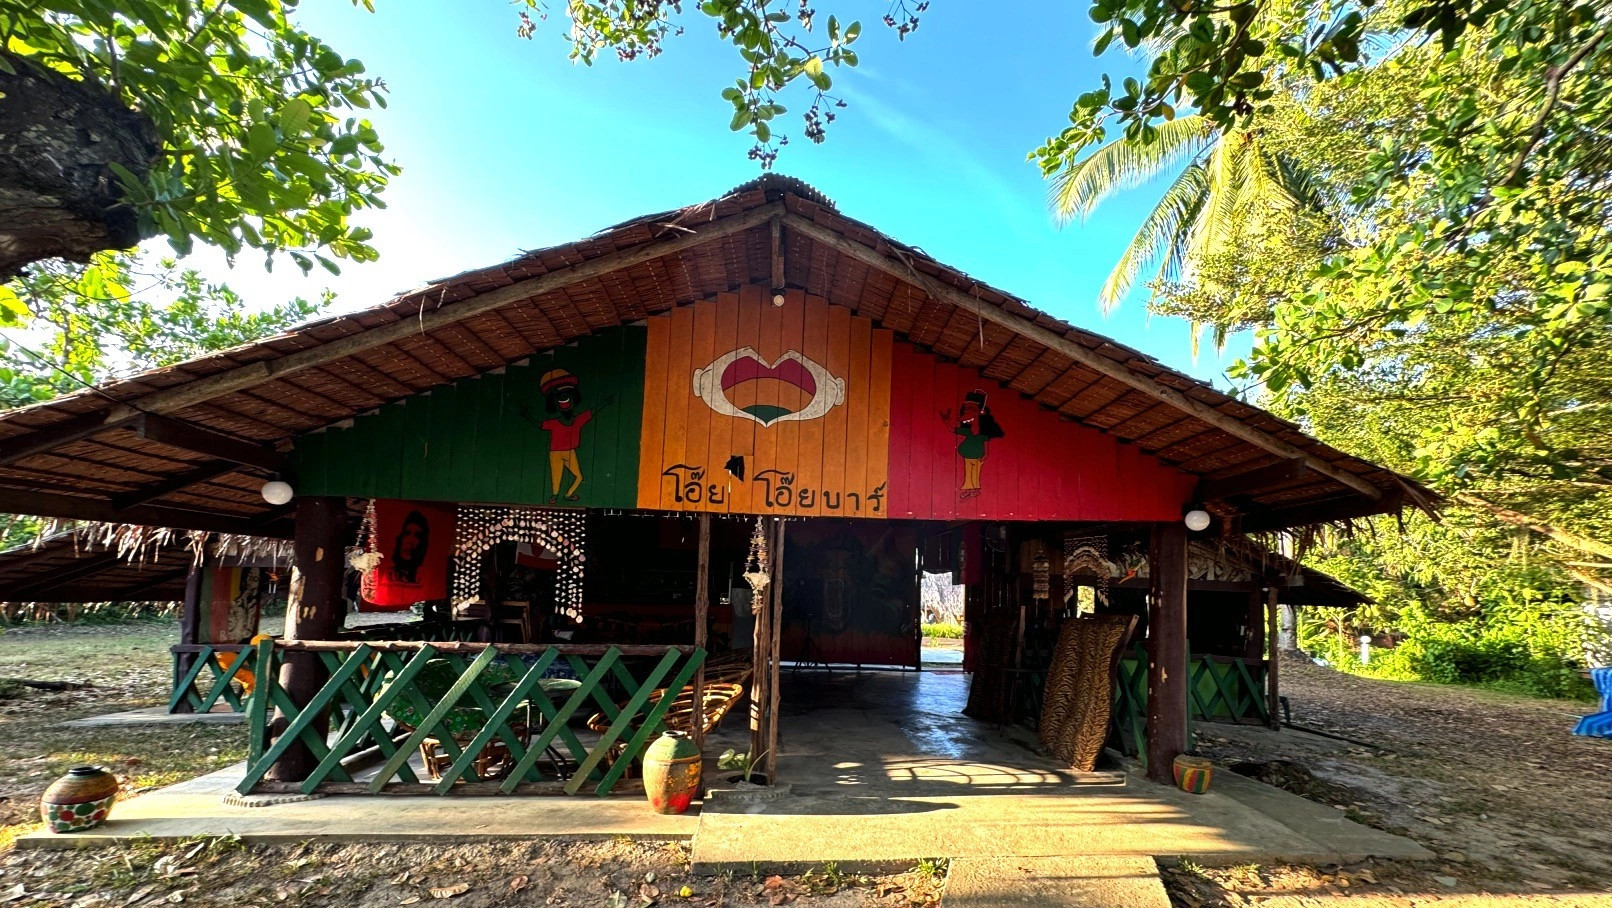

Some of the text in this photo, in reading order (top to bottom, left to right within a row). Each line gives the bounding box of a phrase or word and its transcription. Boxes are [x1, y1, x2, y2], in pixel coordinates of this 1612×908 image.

[662, 464, 887, 512] โอ๊ย โอ๊ยบาร์
